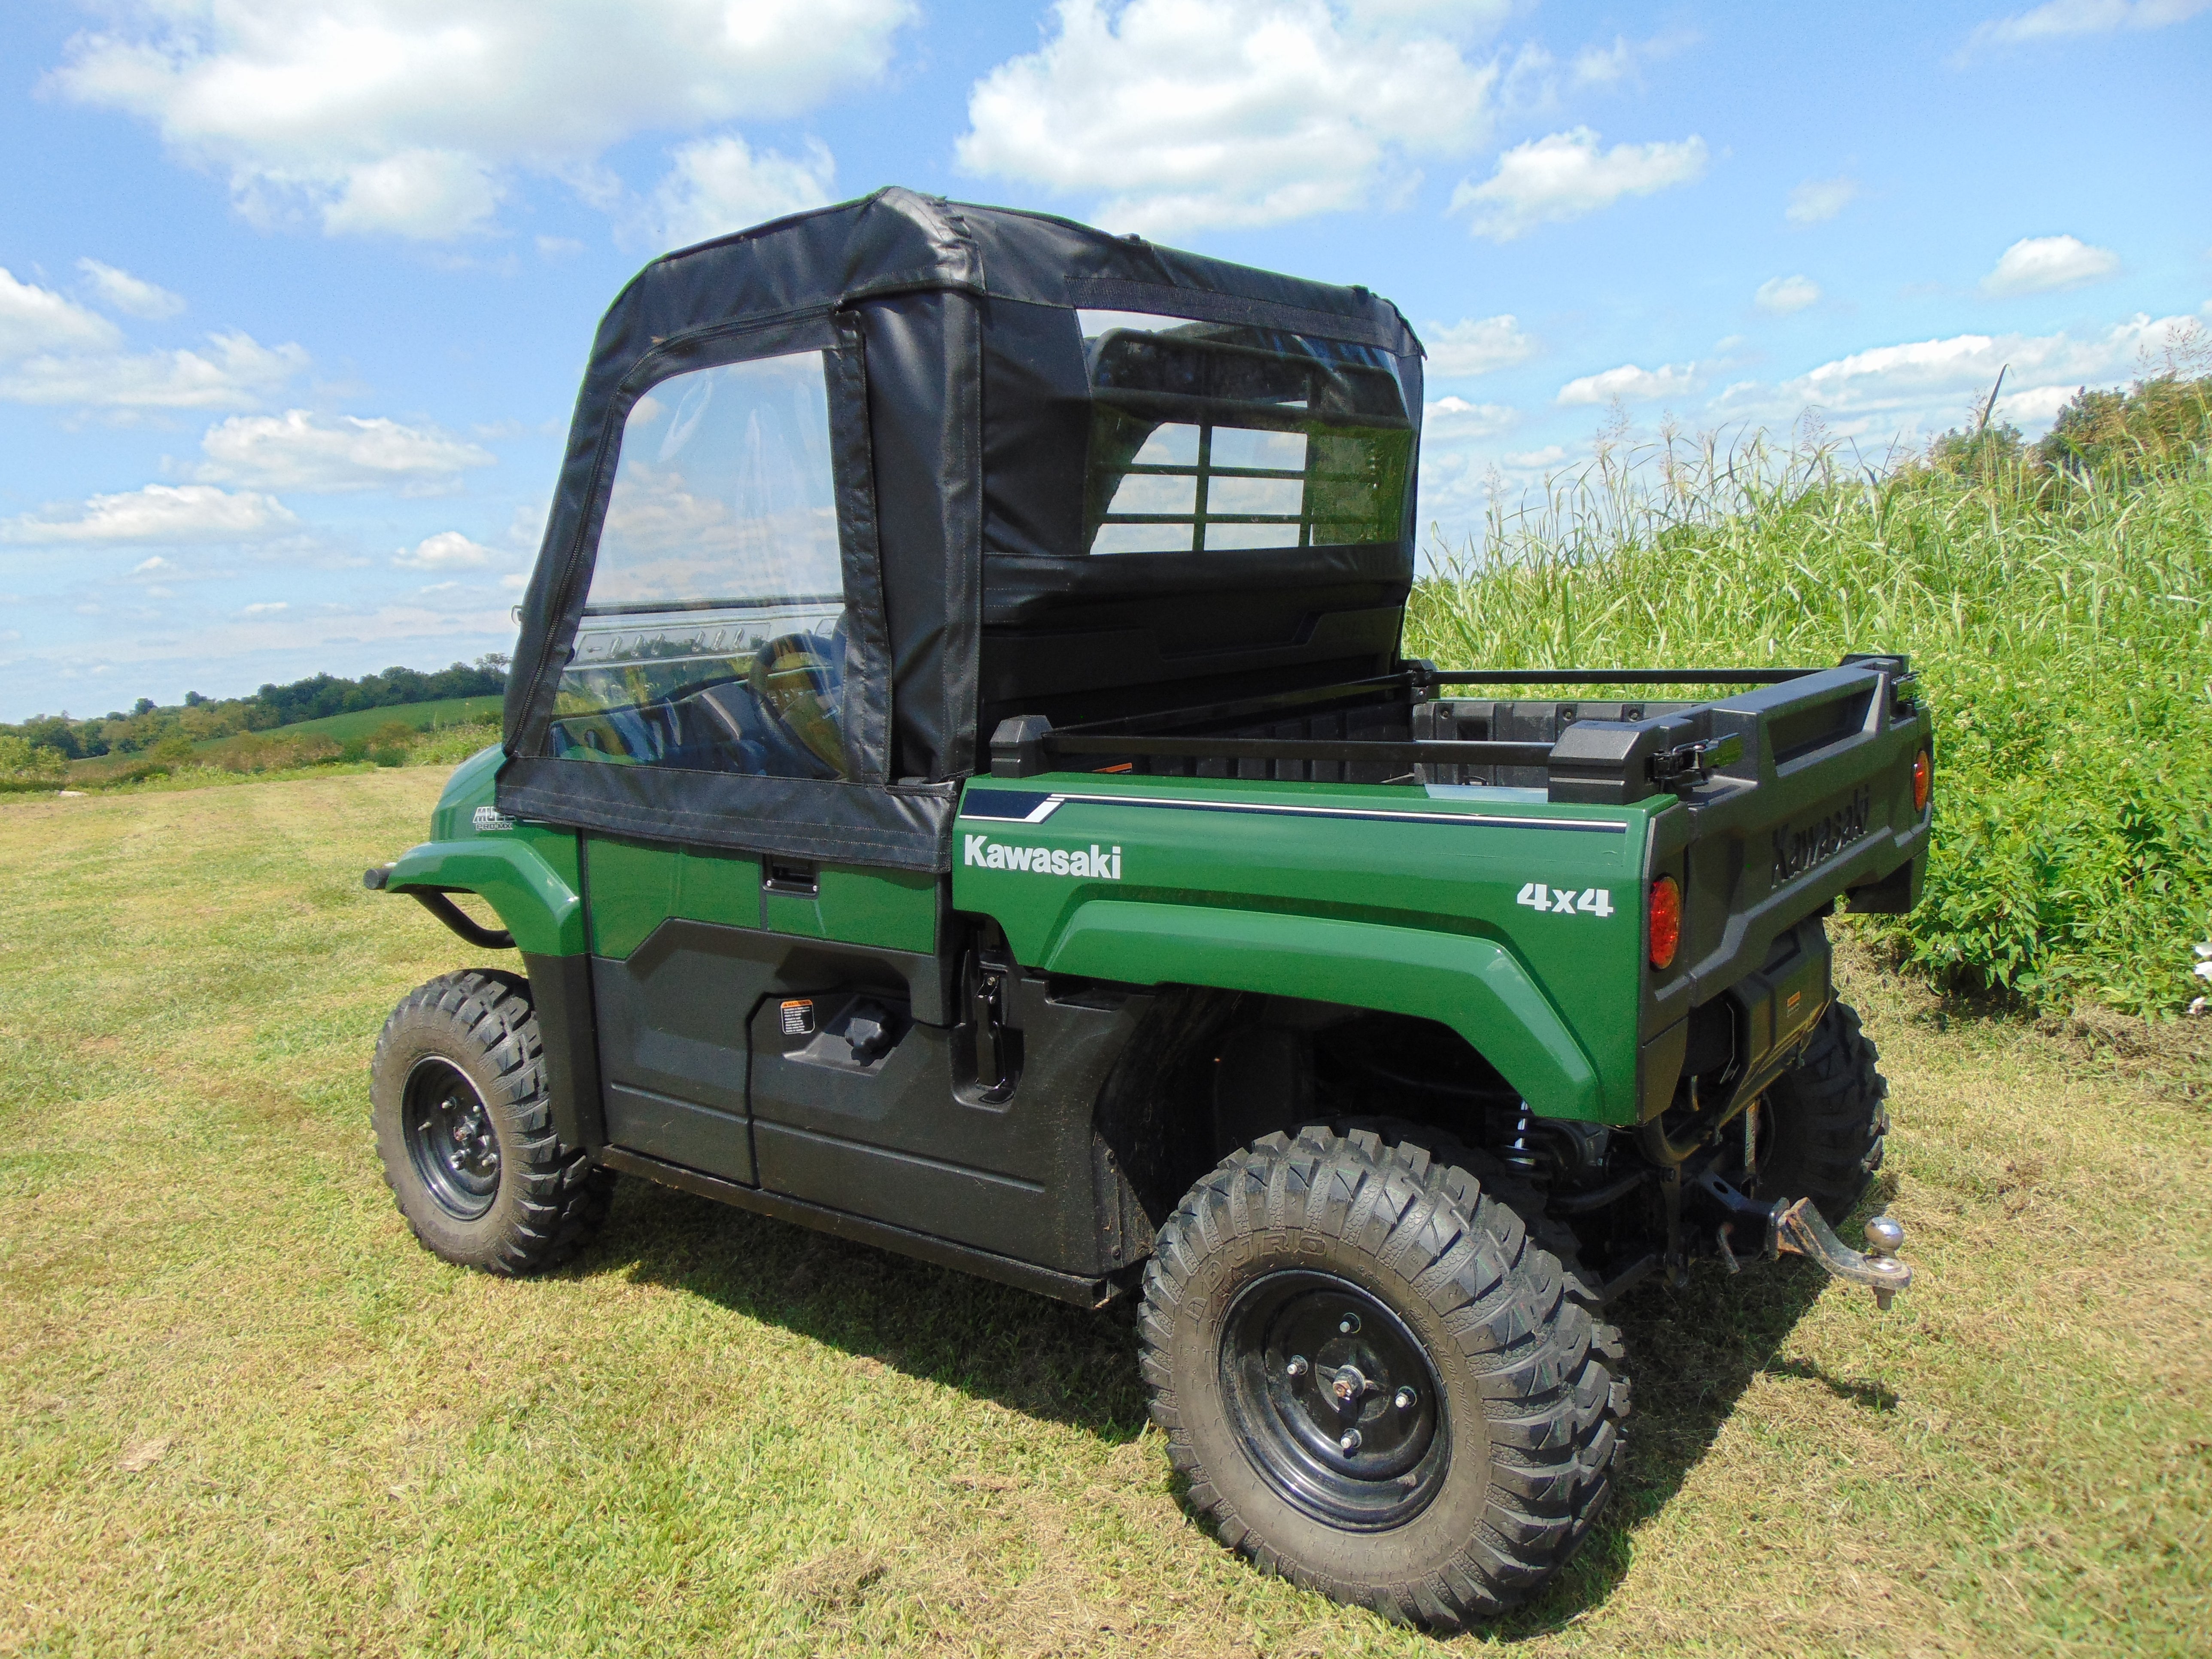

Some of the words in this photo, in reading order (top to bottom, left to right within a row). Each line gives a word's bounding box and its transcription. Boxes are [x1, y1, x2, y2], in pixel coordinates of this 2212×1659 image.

[477, 822, 513, 830] PRO-MX
[1771, 783, 1869, 890] Kawasaki
[964, 834, 1121, 879] Kawasaki
[1517, 883, 1613, 917] 4x4
